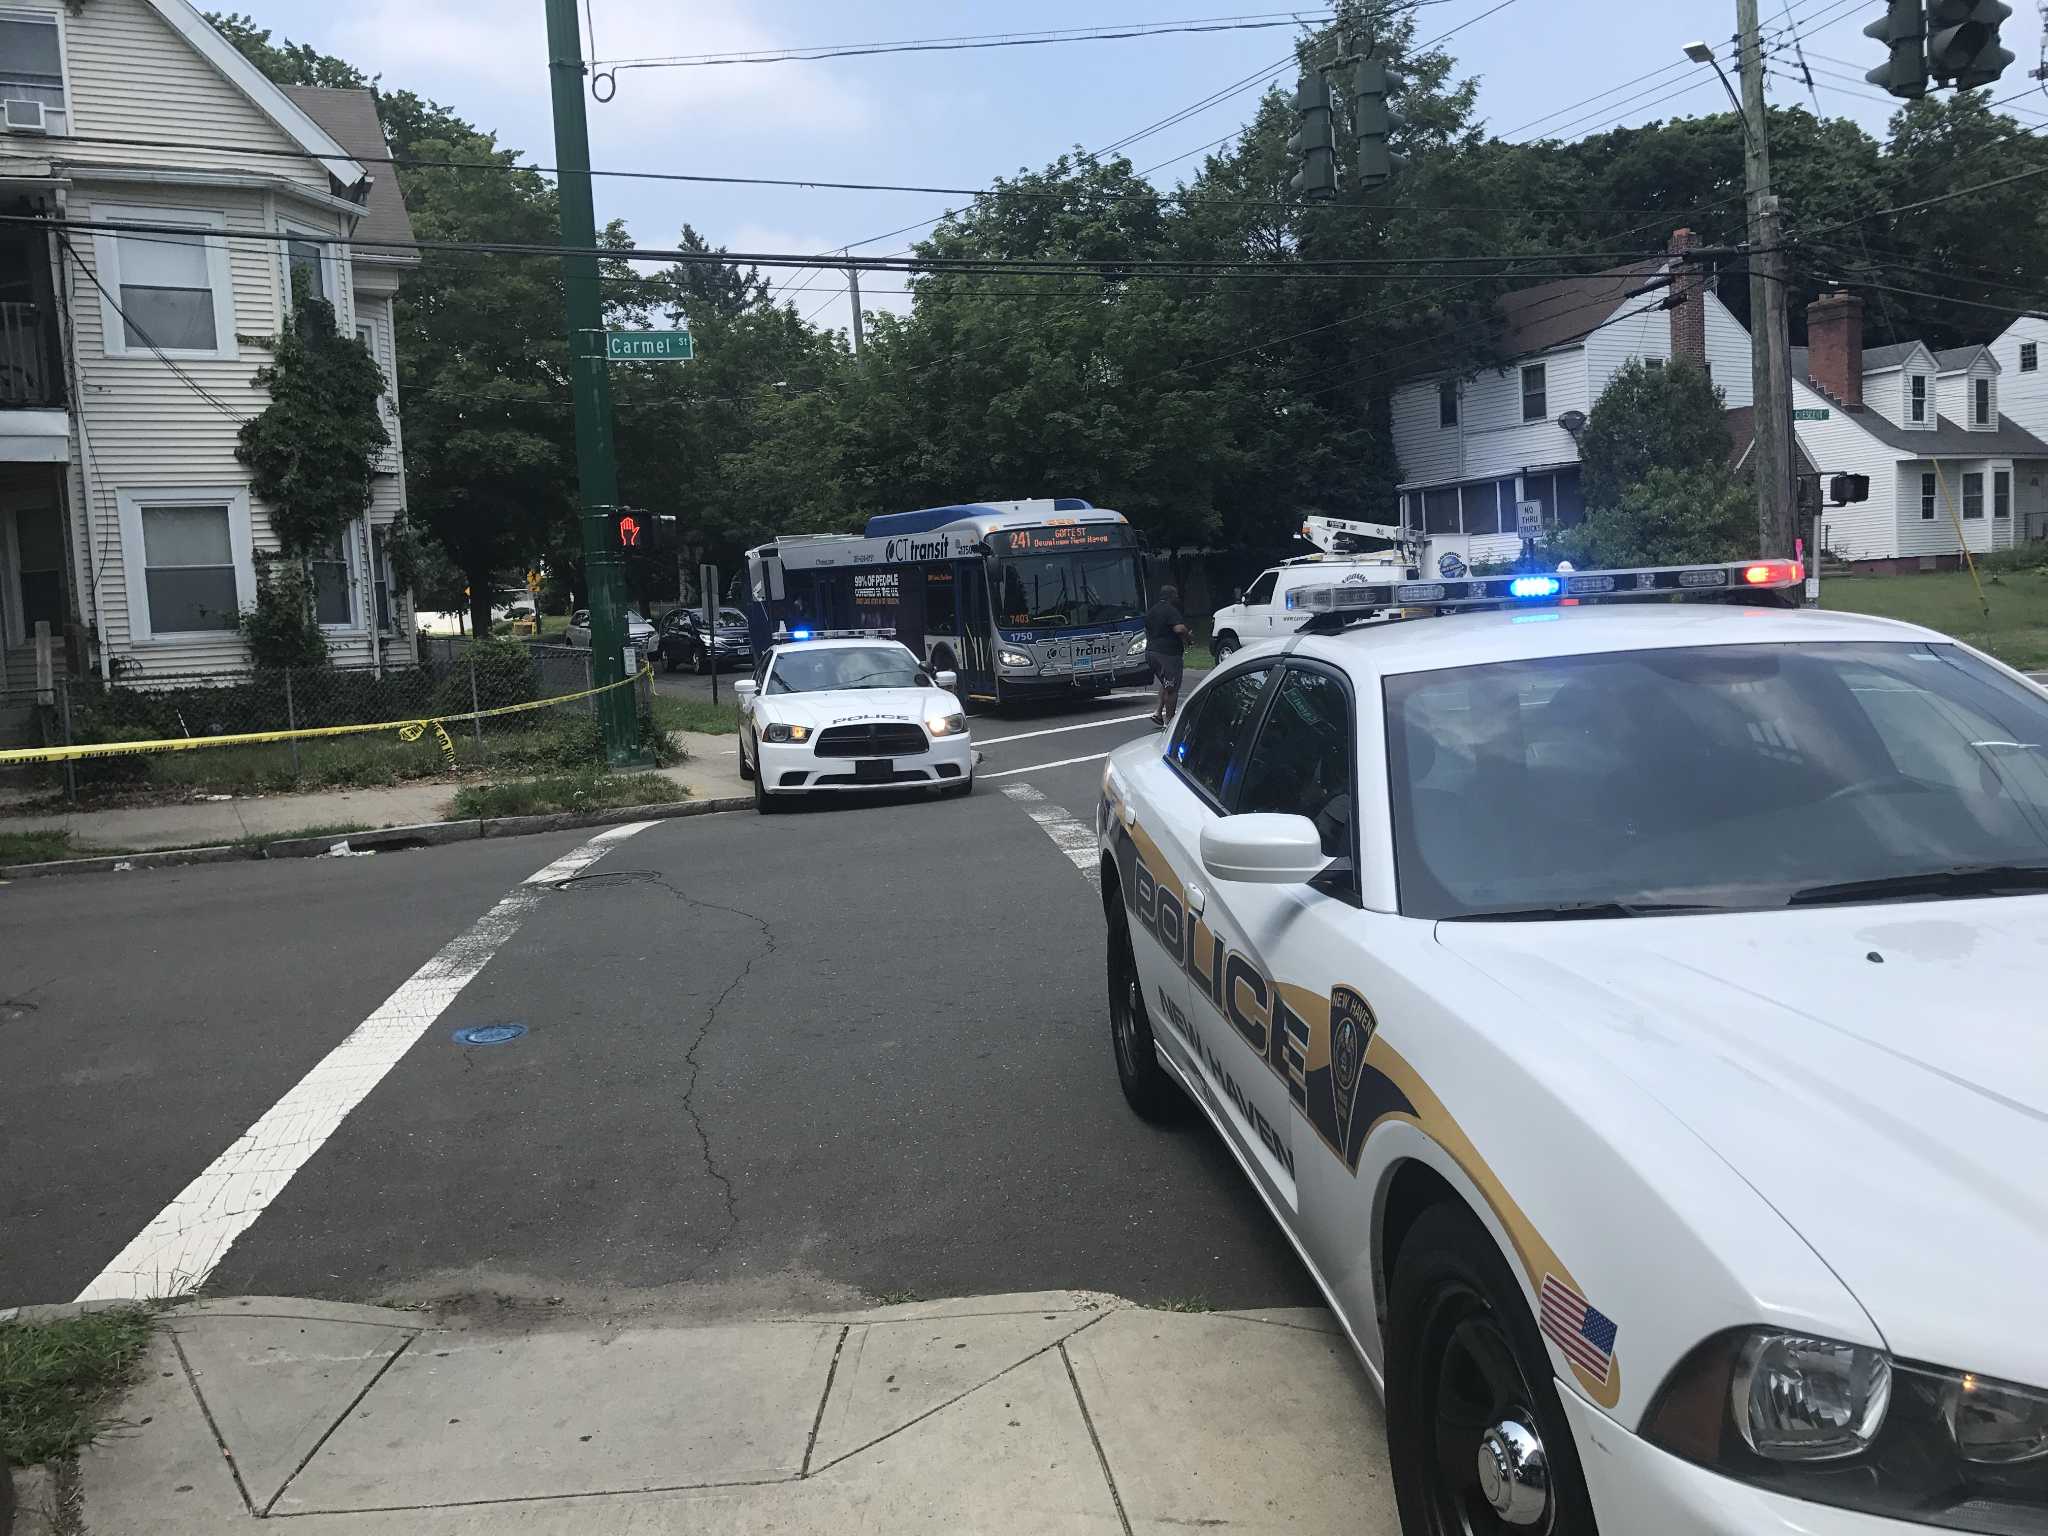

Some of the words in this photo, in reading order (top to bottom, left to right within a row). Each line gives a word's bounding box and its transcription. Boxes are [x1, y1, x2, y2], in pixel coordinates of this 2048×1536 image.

[611, 338, 670, 354] Carmel
[678, 337, 688, 346] St
[1524, 505, 1534, 514] NO
[1522, 515, 1538, 524] THRU
[1009, 531, 1030, 549] 241
[867, 575, 875, 587] OF
[875, 573, 899, 587] PEOPLE
[1010, 632, 1033, 642] 1750
[833, 714, 910, 725] POLICE
[1134, 857, 1311, 1119] POLICE
[1332, 991, 1351, 1009] NEW
[1349, 998, 1374, 1037] HAVEN
[1158, 985, 1204, 1057] NEW
[1206, 1045, 1296, 1183] HAVEN
